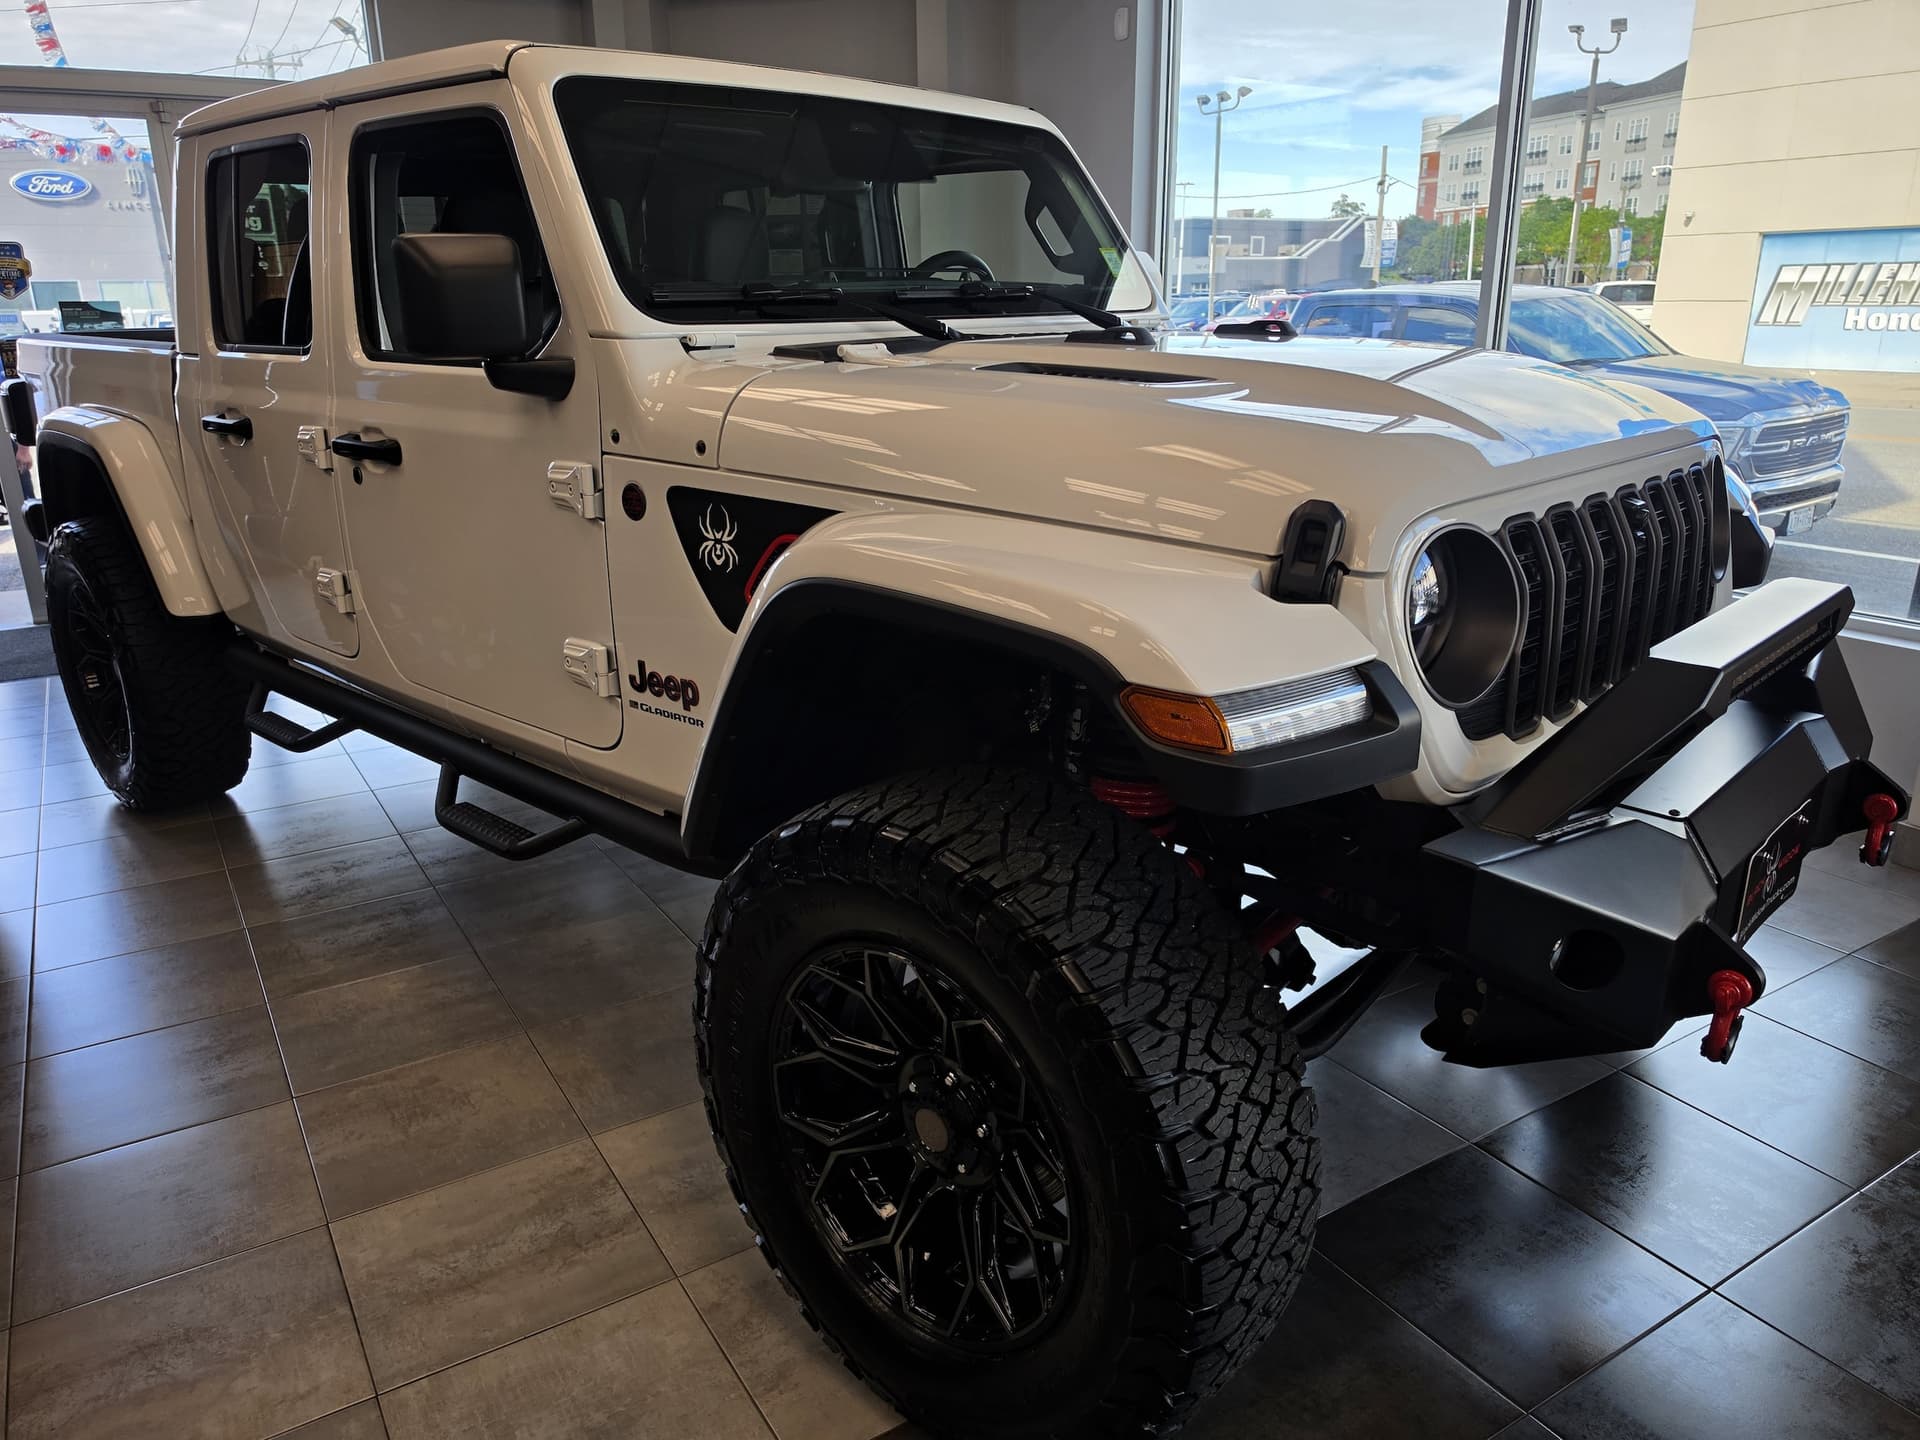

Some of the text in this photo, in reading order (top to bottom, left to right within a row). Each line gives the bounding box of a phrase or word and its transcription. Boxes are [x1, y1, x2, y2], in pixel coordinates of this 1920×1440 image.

[28, 175, 74, 194] Ford
[1754, 261, 1920, 327] MILLEN
[1792, 432, 1833, 449] RAM
[628, 659, 700, 711] Jeep
[640, 703, 705, 729] GLADIATOR
